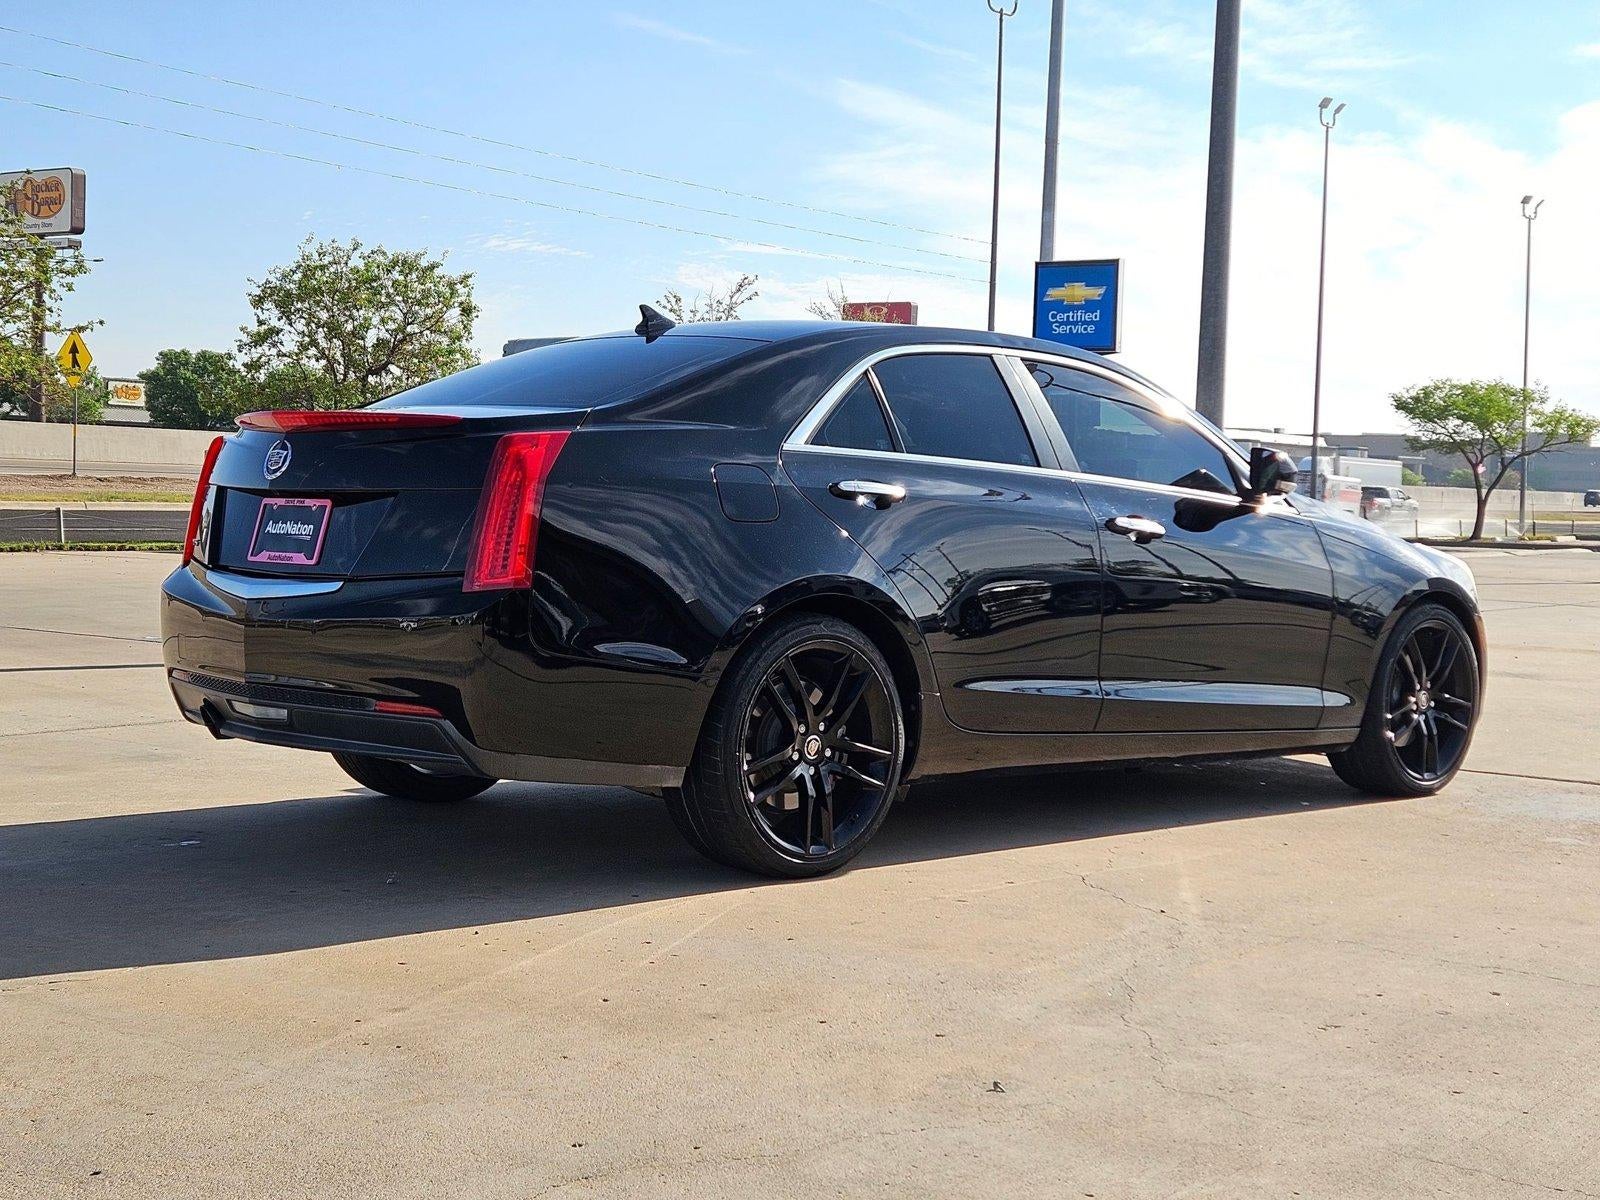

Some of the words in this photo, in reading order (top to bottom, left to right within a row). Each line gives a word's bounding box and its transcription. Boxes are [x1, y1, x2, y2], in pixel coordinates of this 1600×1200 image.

[1048, 310, 1100, 322] Certified
[1052, 323, 1095, 334] Service
[264, 520, 314, 536] AutoNation
[266, 553, 293, 562] AutoNation
